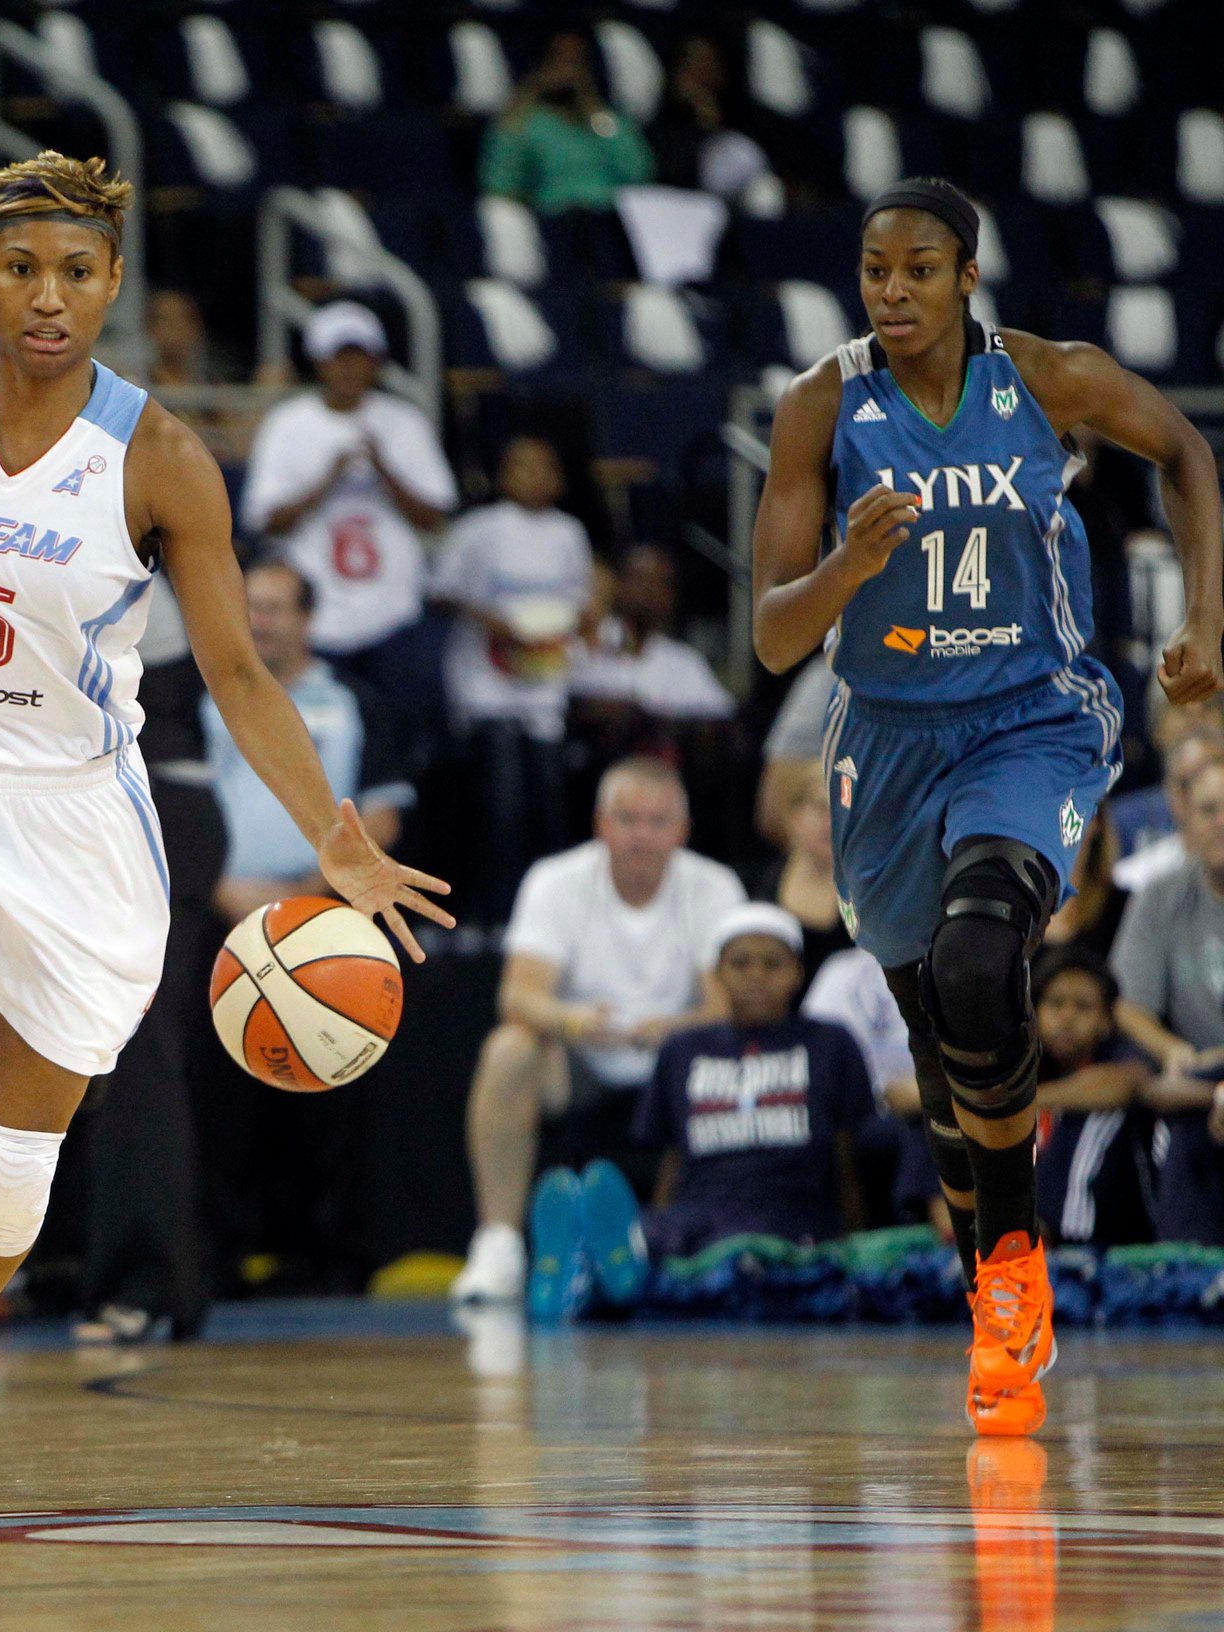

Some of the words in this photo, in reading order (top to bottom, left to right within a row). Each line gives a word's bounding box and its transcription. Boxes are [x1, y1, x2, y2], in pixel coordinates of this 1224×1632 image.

[330, 514, 381, 582] 6
[920, 526, 991, 612] 14
[929, 623, 1023, 646] boost
[930, 643, 982, 658] mobile
